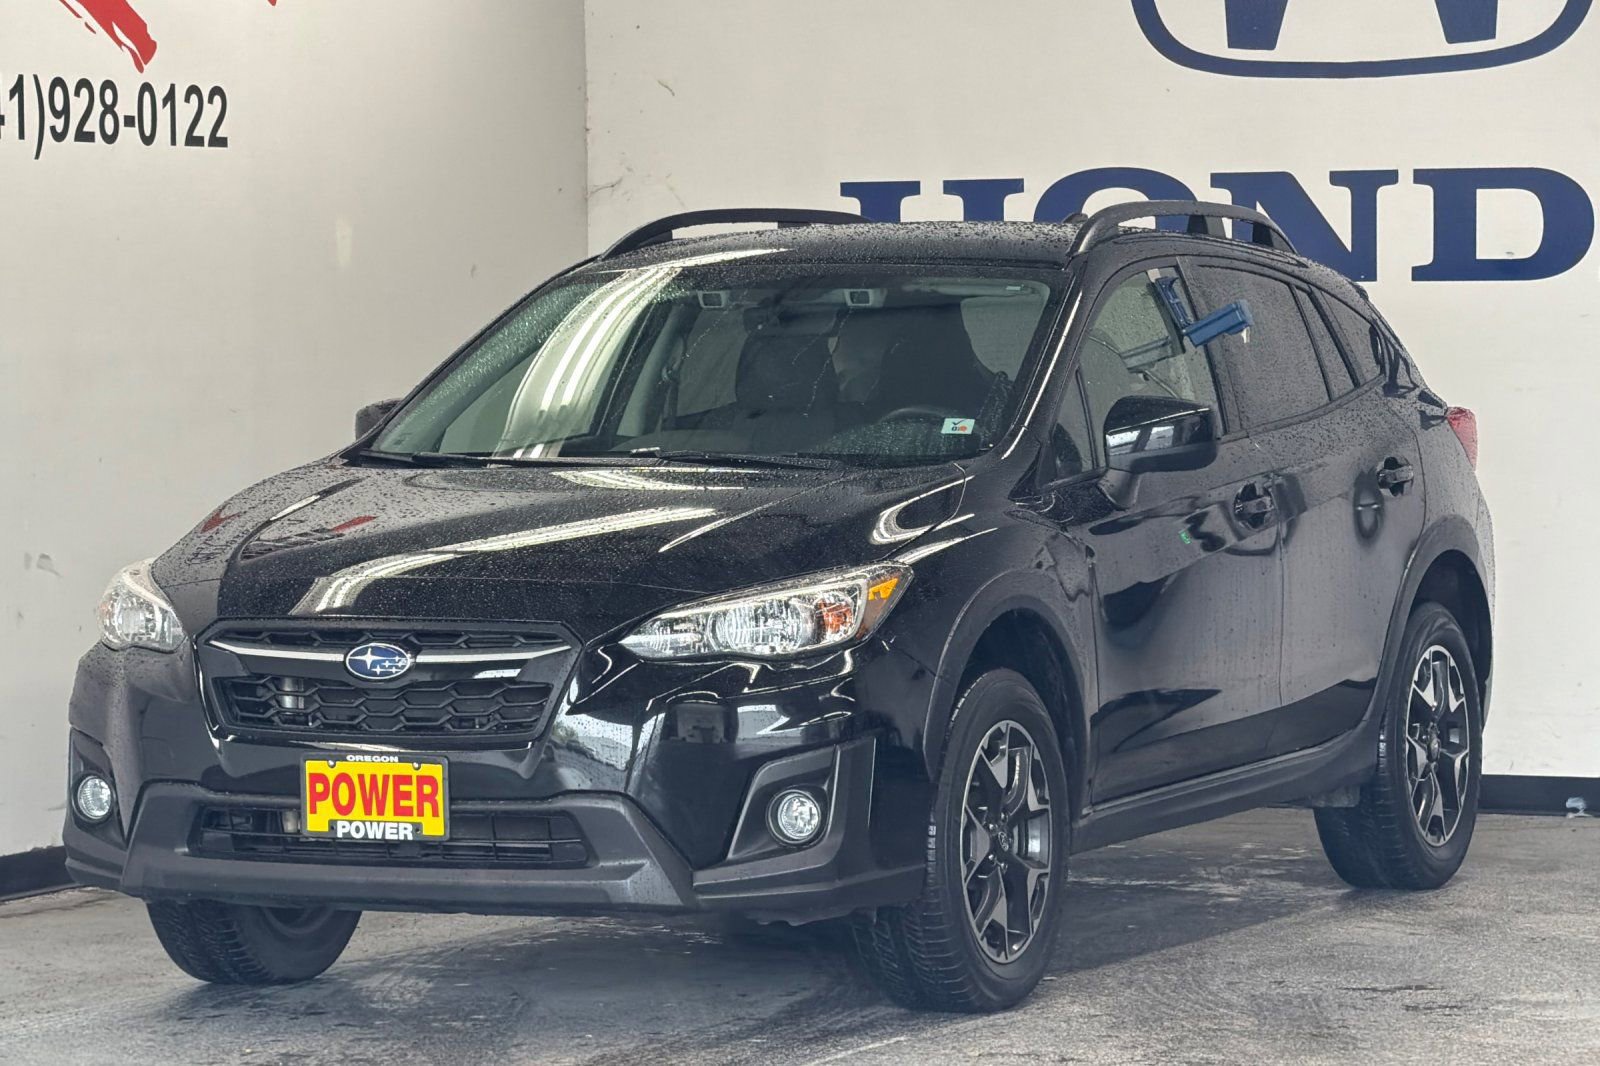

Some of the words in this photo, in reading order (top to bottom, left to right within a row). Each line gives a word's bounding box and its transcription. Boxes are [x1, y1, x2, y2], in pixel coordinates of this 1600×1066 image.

[0, 74, 228, 160] 1)928-0122
[346, 754, 399, 763] OREGON
[308, 772, 440, 818] POWER
[336, 820, 414, 840] POWER
